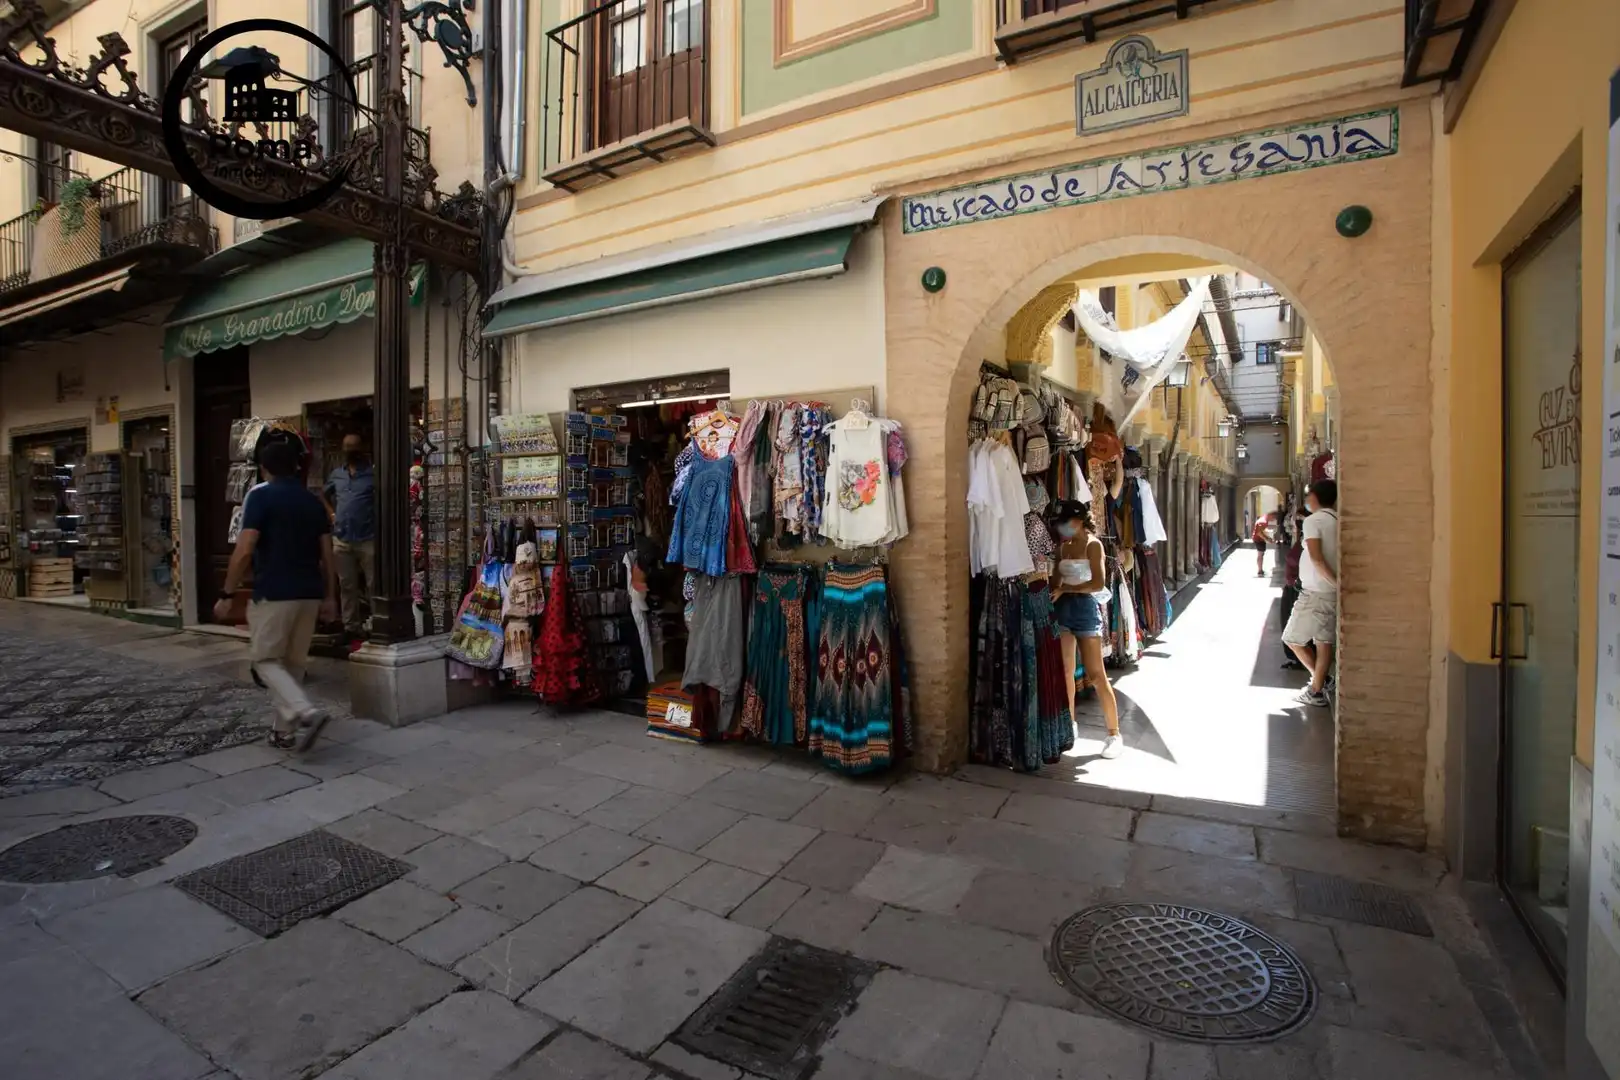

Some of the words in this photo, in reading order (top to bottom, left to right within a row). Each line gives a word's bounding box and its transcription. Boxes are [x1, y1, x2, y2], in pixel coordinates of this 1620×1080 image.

[1083, 71, 1180, 118] ALCAICERIA
[1040, 173, 1086, 203] de
[1091, 123, 1391, 195] Artesania
[223, 299, 328, 343] Granadino
[1152, 902, 1256, 941] NACIONAL
